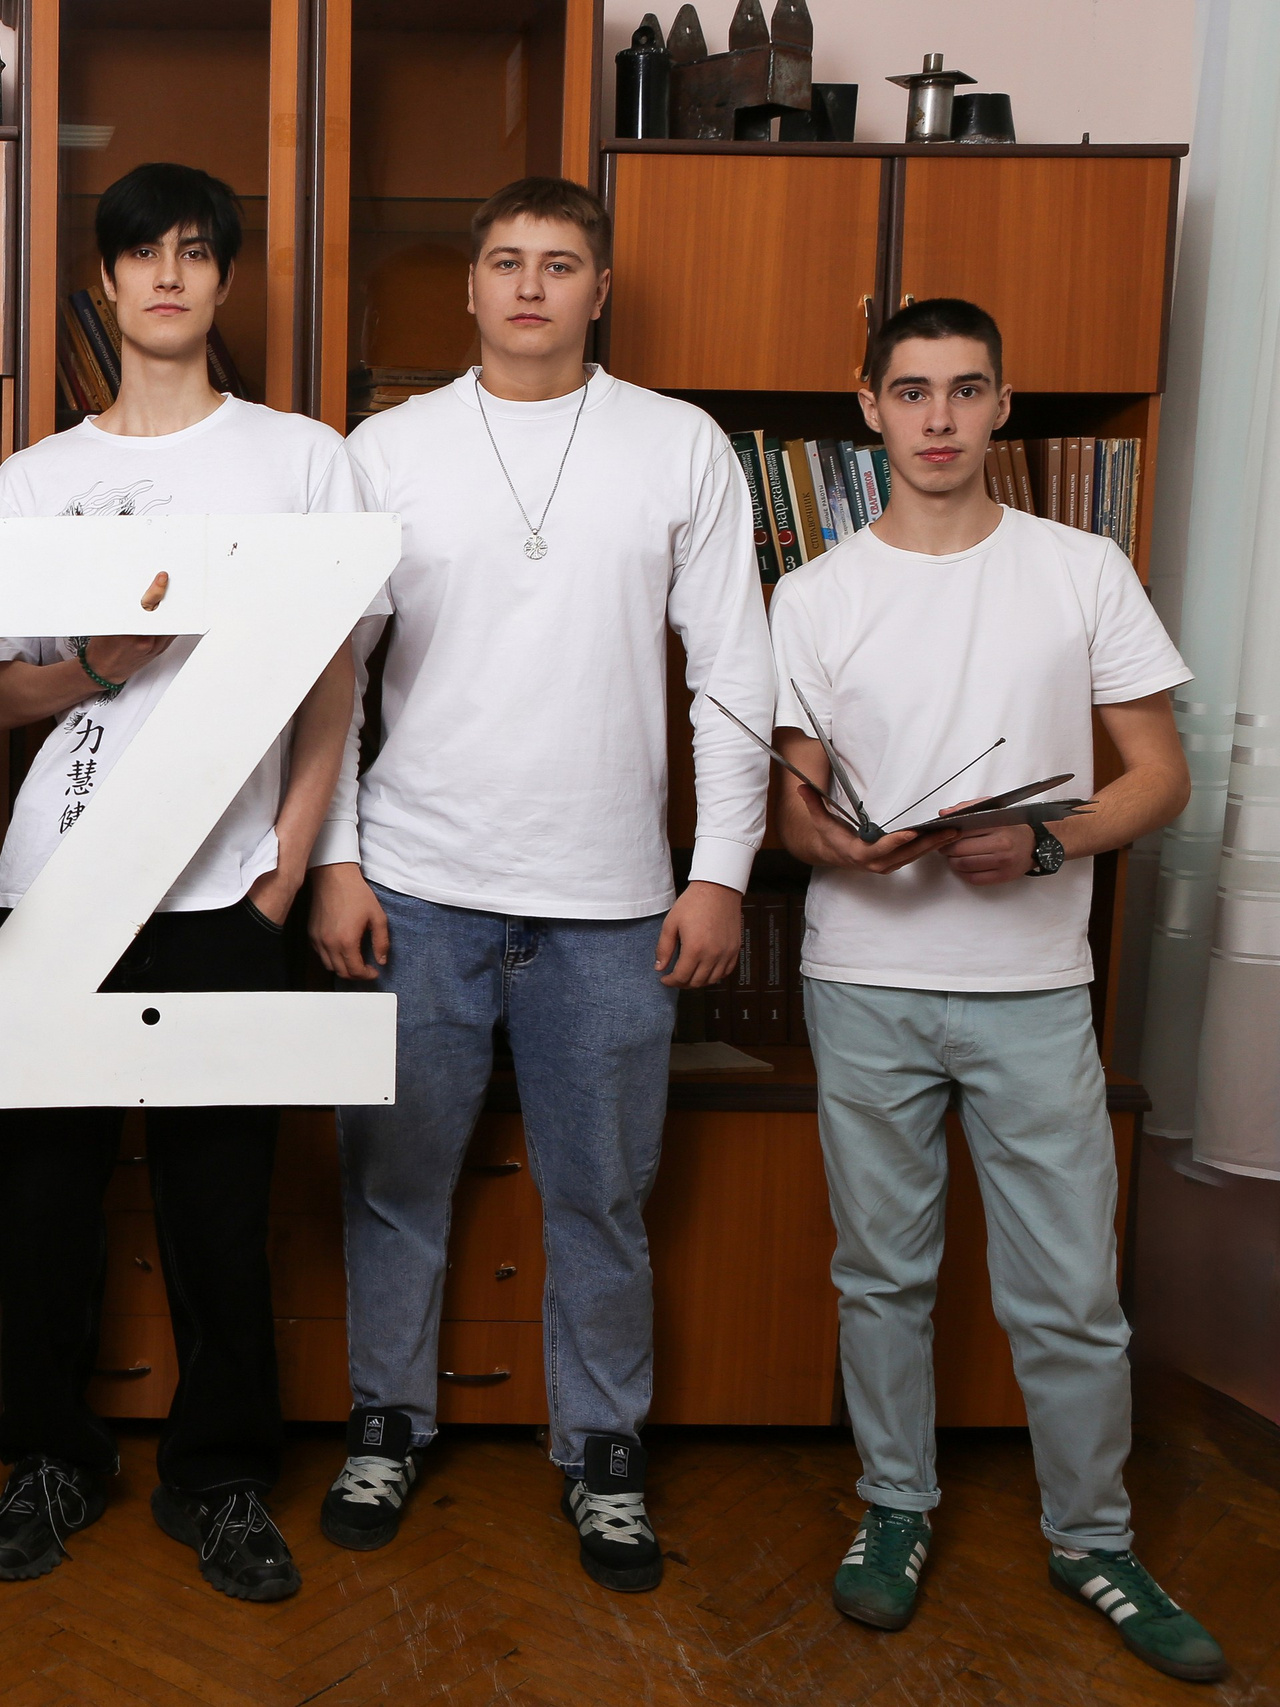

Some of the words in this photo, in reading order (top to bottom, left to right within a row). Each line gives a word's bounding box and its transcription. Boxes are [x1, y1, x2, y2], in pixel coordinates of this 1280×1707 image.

[863, 470, 880, 515] СВАРЩИКОВ
[771, 485, 793, 545] Сварка
[802, 491, 819, 550] СПРАВОЧНИК
[759, 555, 770, 571] 1
[785, 555, 797, 571] 3
[714, 1008, 720, 1019] 1
[742, 1008, 750, 1020] 1
[771, 1008, 779, 1020] 1
